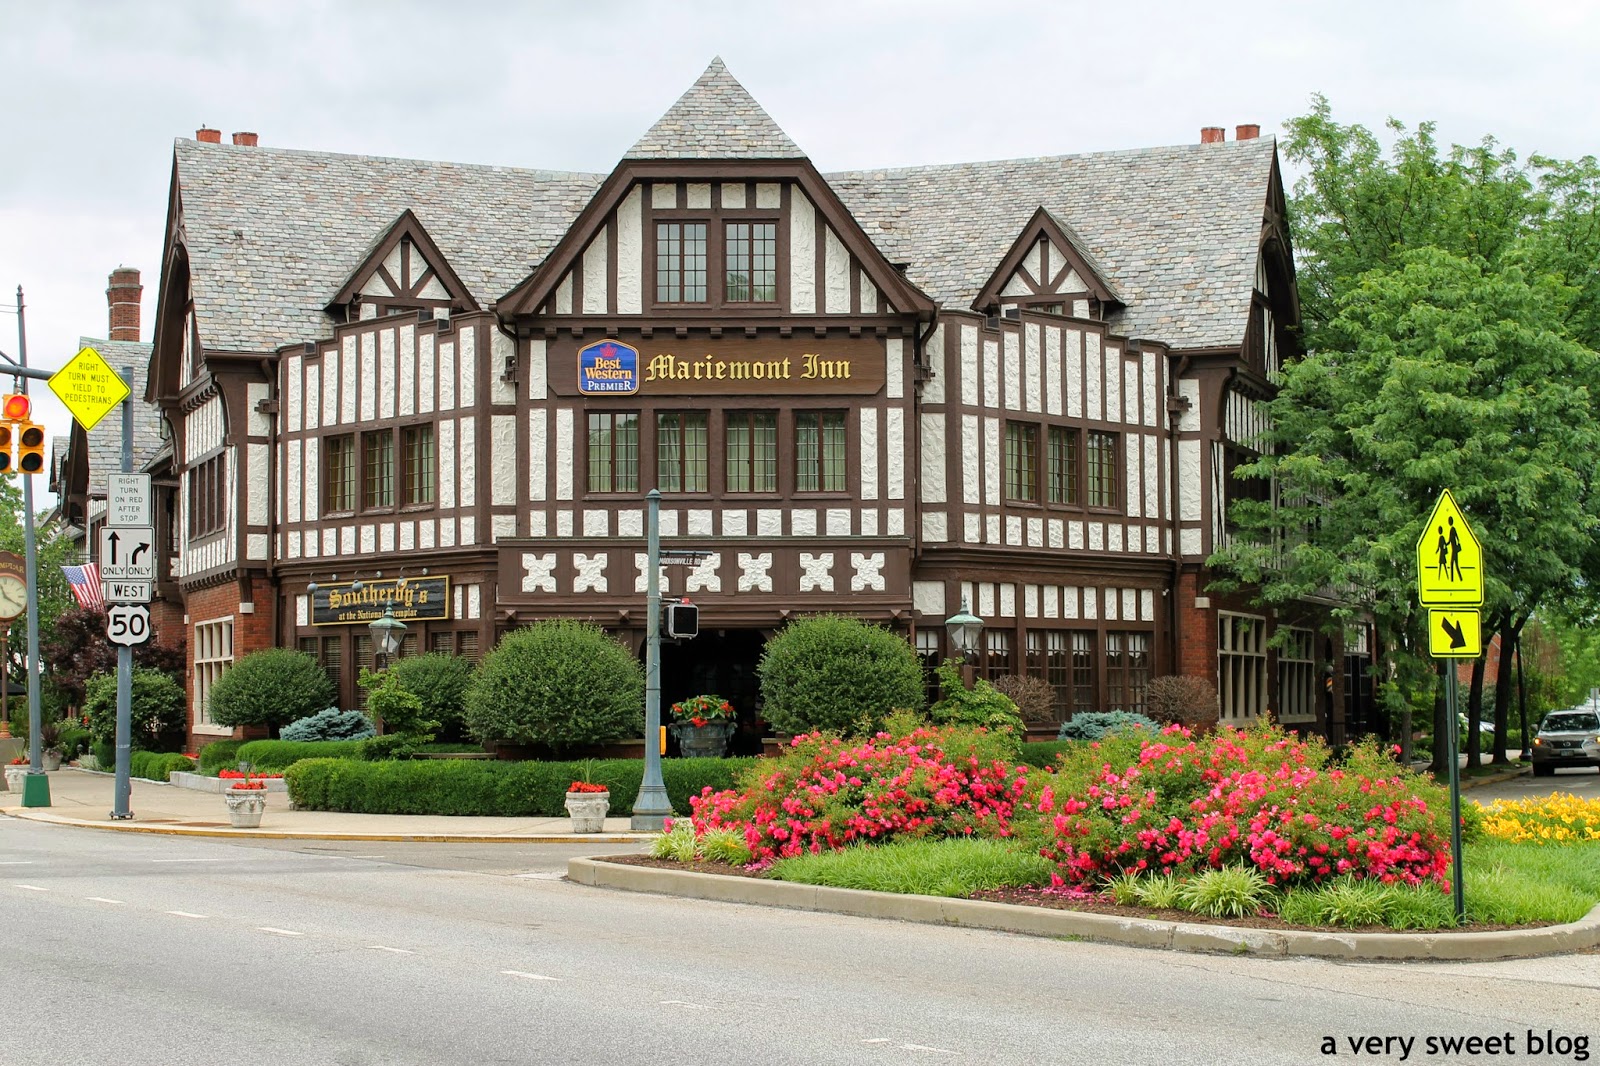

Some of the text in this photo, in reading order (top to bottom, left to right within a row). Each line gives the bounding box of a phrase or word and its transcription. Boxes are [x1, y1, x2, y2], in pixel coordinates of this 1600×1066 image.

[78, 362, 99, 371] RIGHT
[594, 357, 621, 370] Best
[645, 353, 851, 382] Mariemont Inn
[68, 372, 109, 383] TURN MUST
[584, 367, 632, 380] Western
[72, 384, 92, 392] YIELD
[64, 393, 112, 405] PEDESTRIANS
[118, 505, 141, 513] AFTER
[102, 567, 126, 576] ONLY
[128, 567, 151, 576] ONLY
[114, 584, 145, 598] WEST
[338, 608, 418, 621] at the National xemplar
[112, 614, 145, 636] 50
